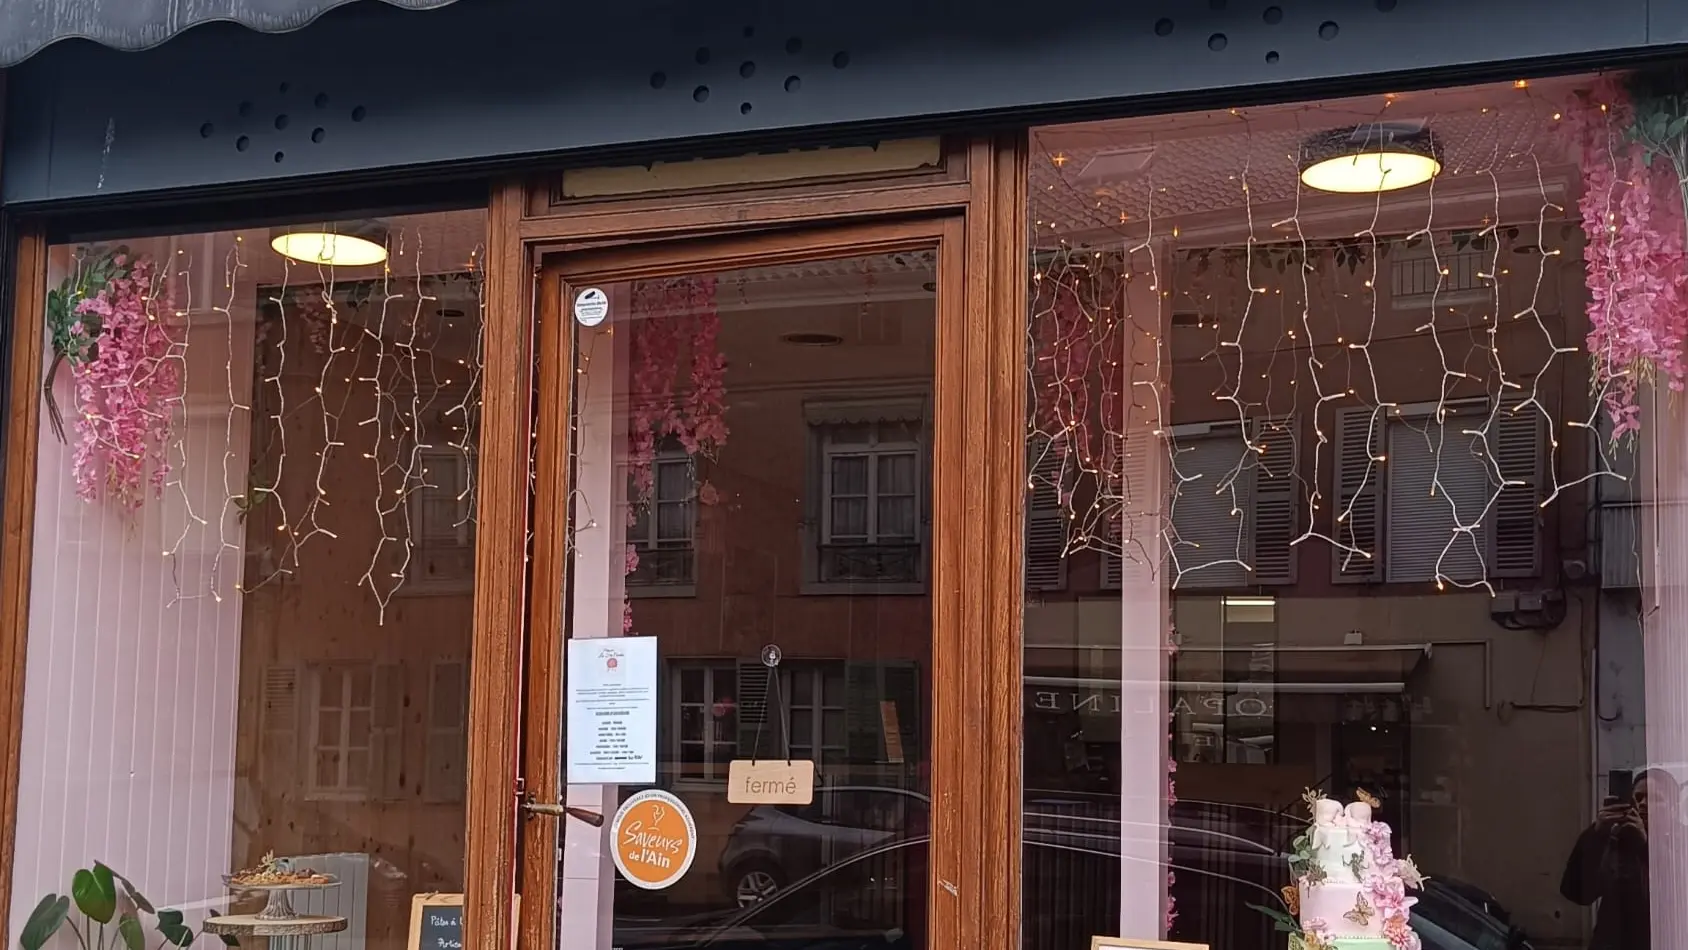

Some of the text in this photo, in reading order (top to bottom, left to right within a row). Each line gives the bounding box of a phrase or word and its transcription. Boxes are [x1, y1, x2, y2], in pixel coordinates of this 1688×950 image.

[745, 776, 797, 795] fermé
[628, 848, 671, 868] de l'Ain
